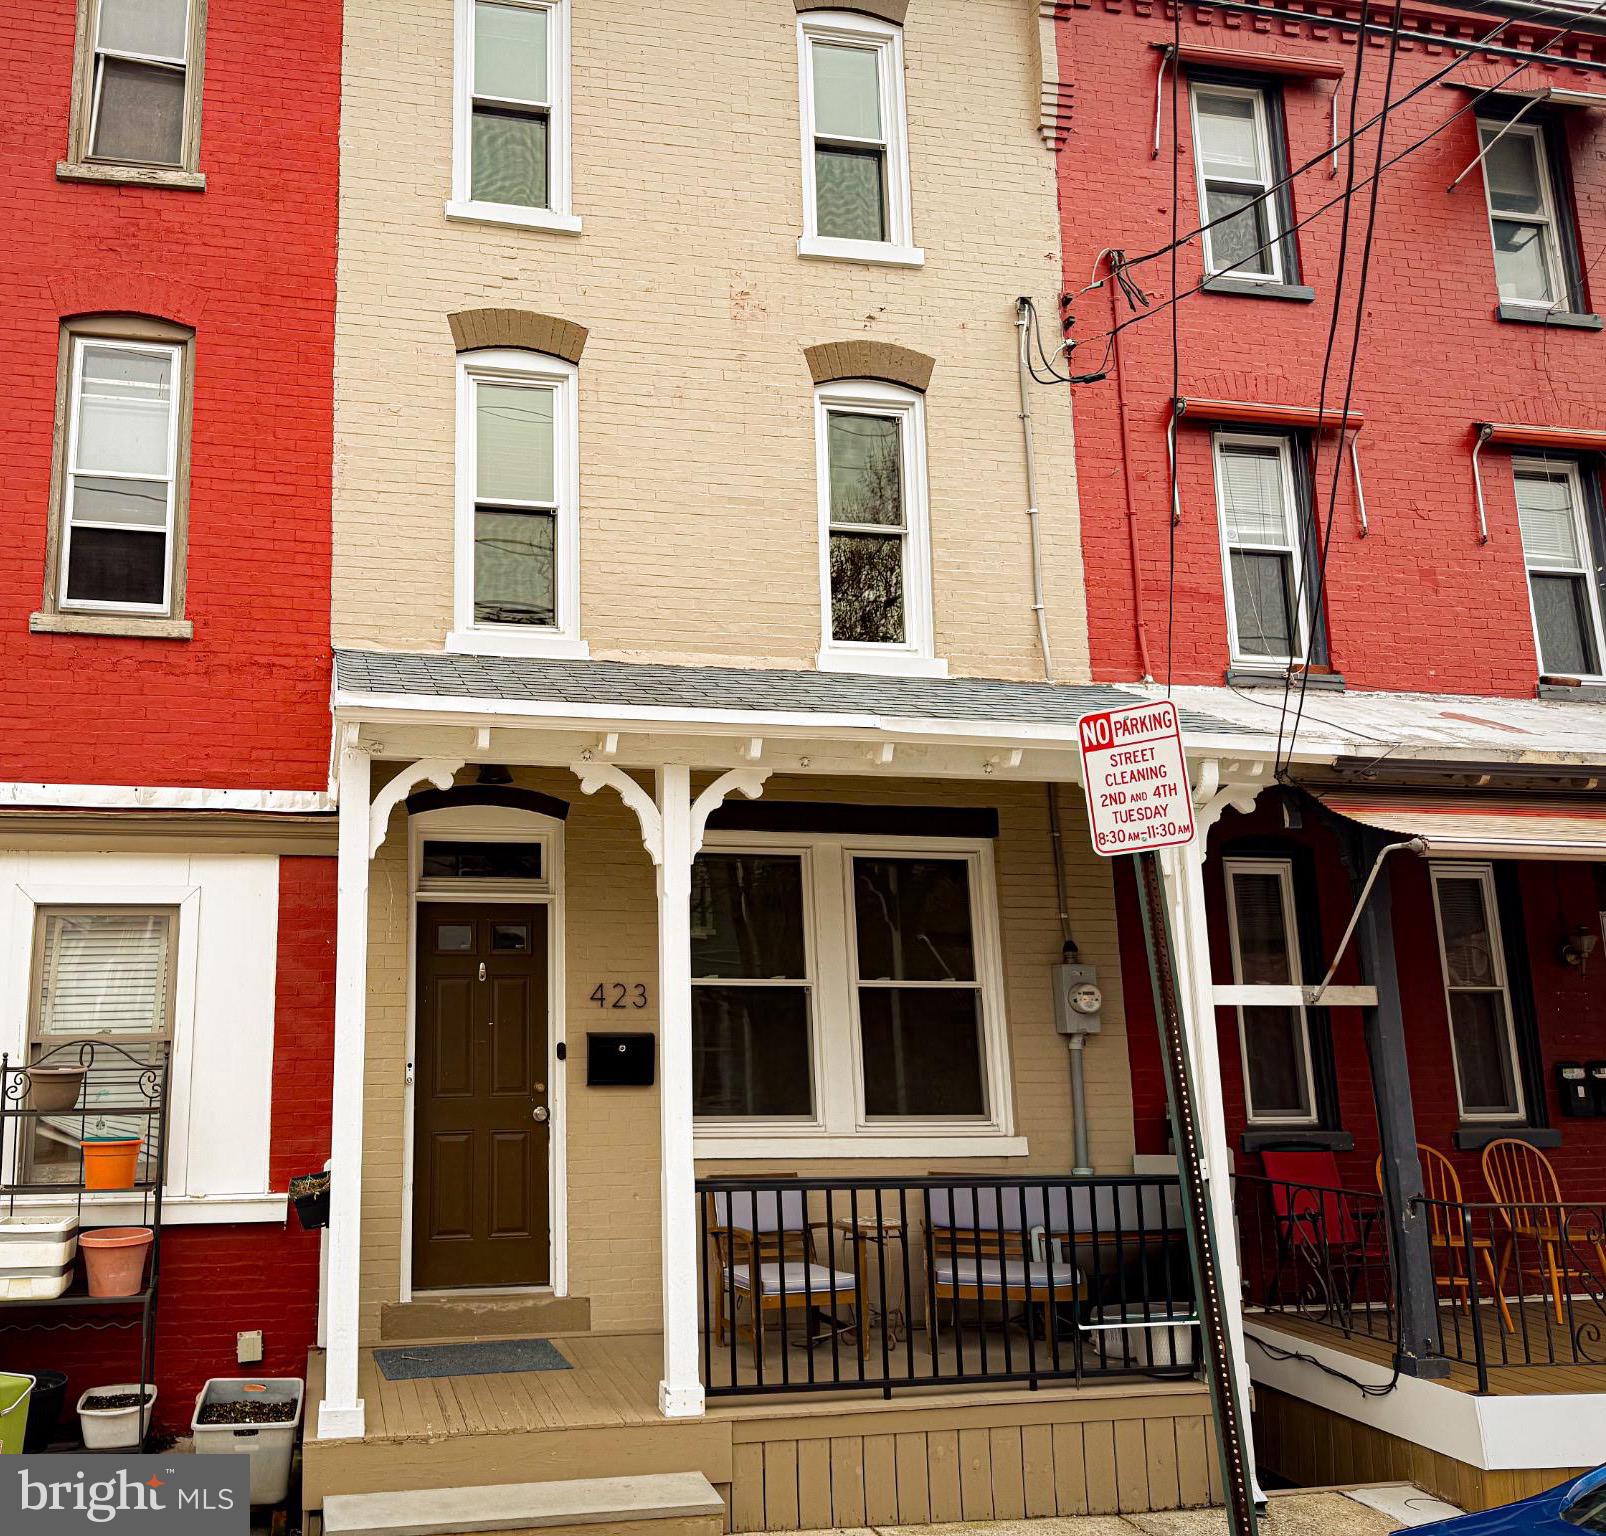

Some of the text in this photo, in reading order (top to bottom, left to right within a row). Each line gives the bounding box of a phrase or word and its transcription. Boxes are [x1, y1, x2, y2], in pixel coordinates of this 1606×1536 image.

[1081, 710, 1173, 748] NO PARKING
[1109, 746, 1156, 768] STREET
[1104, 764, 1168, 787] CLEANING
[1100, 782, 1178, 808] 2ND AND 4TH
[1111, 803, 1169, 825] TUESDAY
[1098, 829, 1126, 846] 8:30
[1177, 823, 1191, 835] AM
[589, 983, 647, 1009] 423
